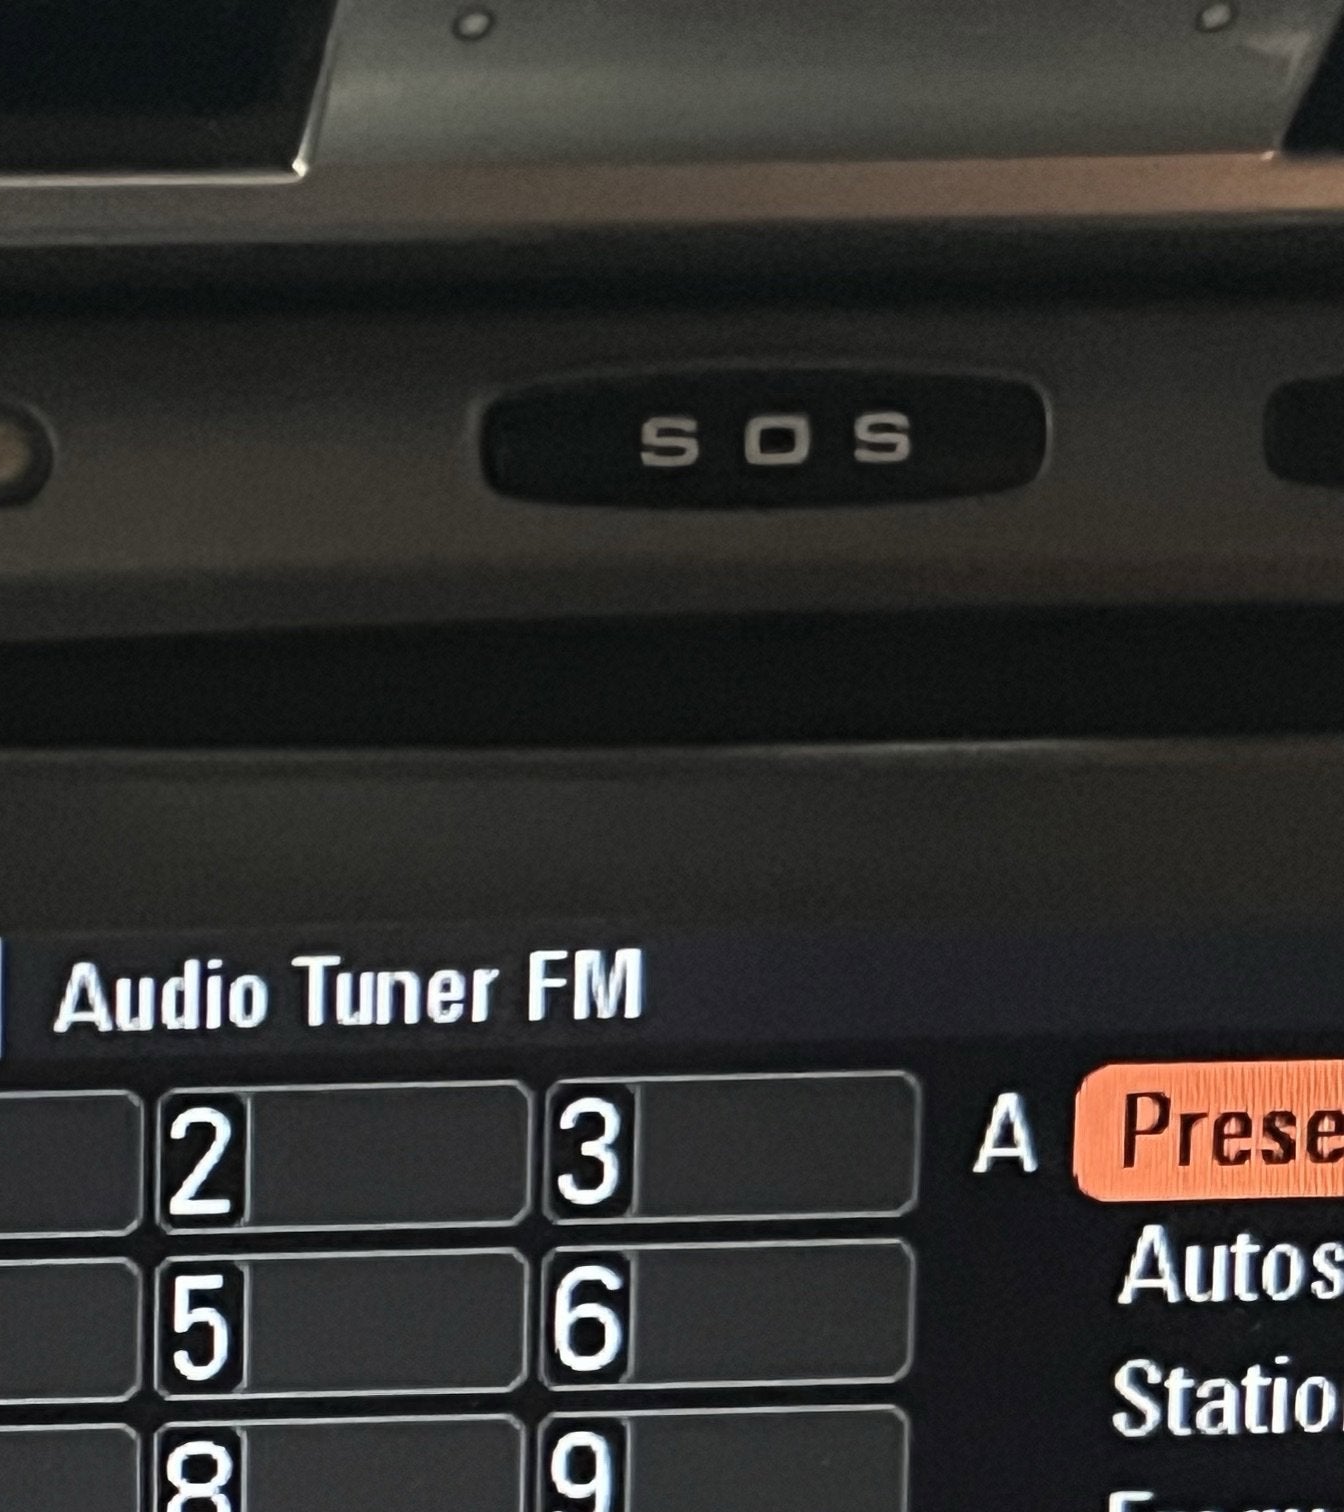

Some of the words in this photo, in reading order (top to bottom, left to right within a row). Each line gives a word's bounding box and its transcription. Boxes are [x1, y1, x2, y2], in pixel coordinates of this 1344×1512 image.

[53, 958, 268, 1033] Audio
[291, 955, 500, 1027] Tuner
[528, 947, 643, 1022] FM
[169, 1106, 232, 1215] 2
[557, 1097, 621, 1205] 3
[972, 1092, 1038, 1173] A
[173, 1274, 229, 1381] 5
[554, 1265, 622, 1372] 6
[1112, 1355, 1344, 1438] Statio
